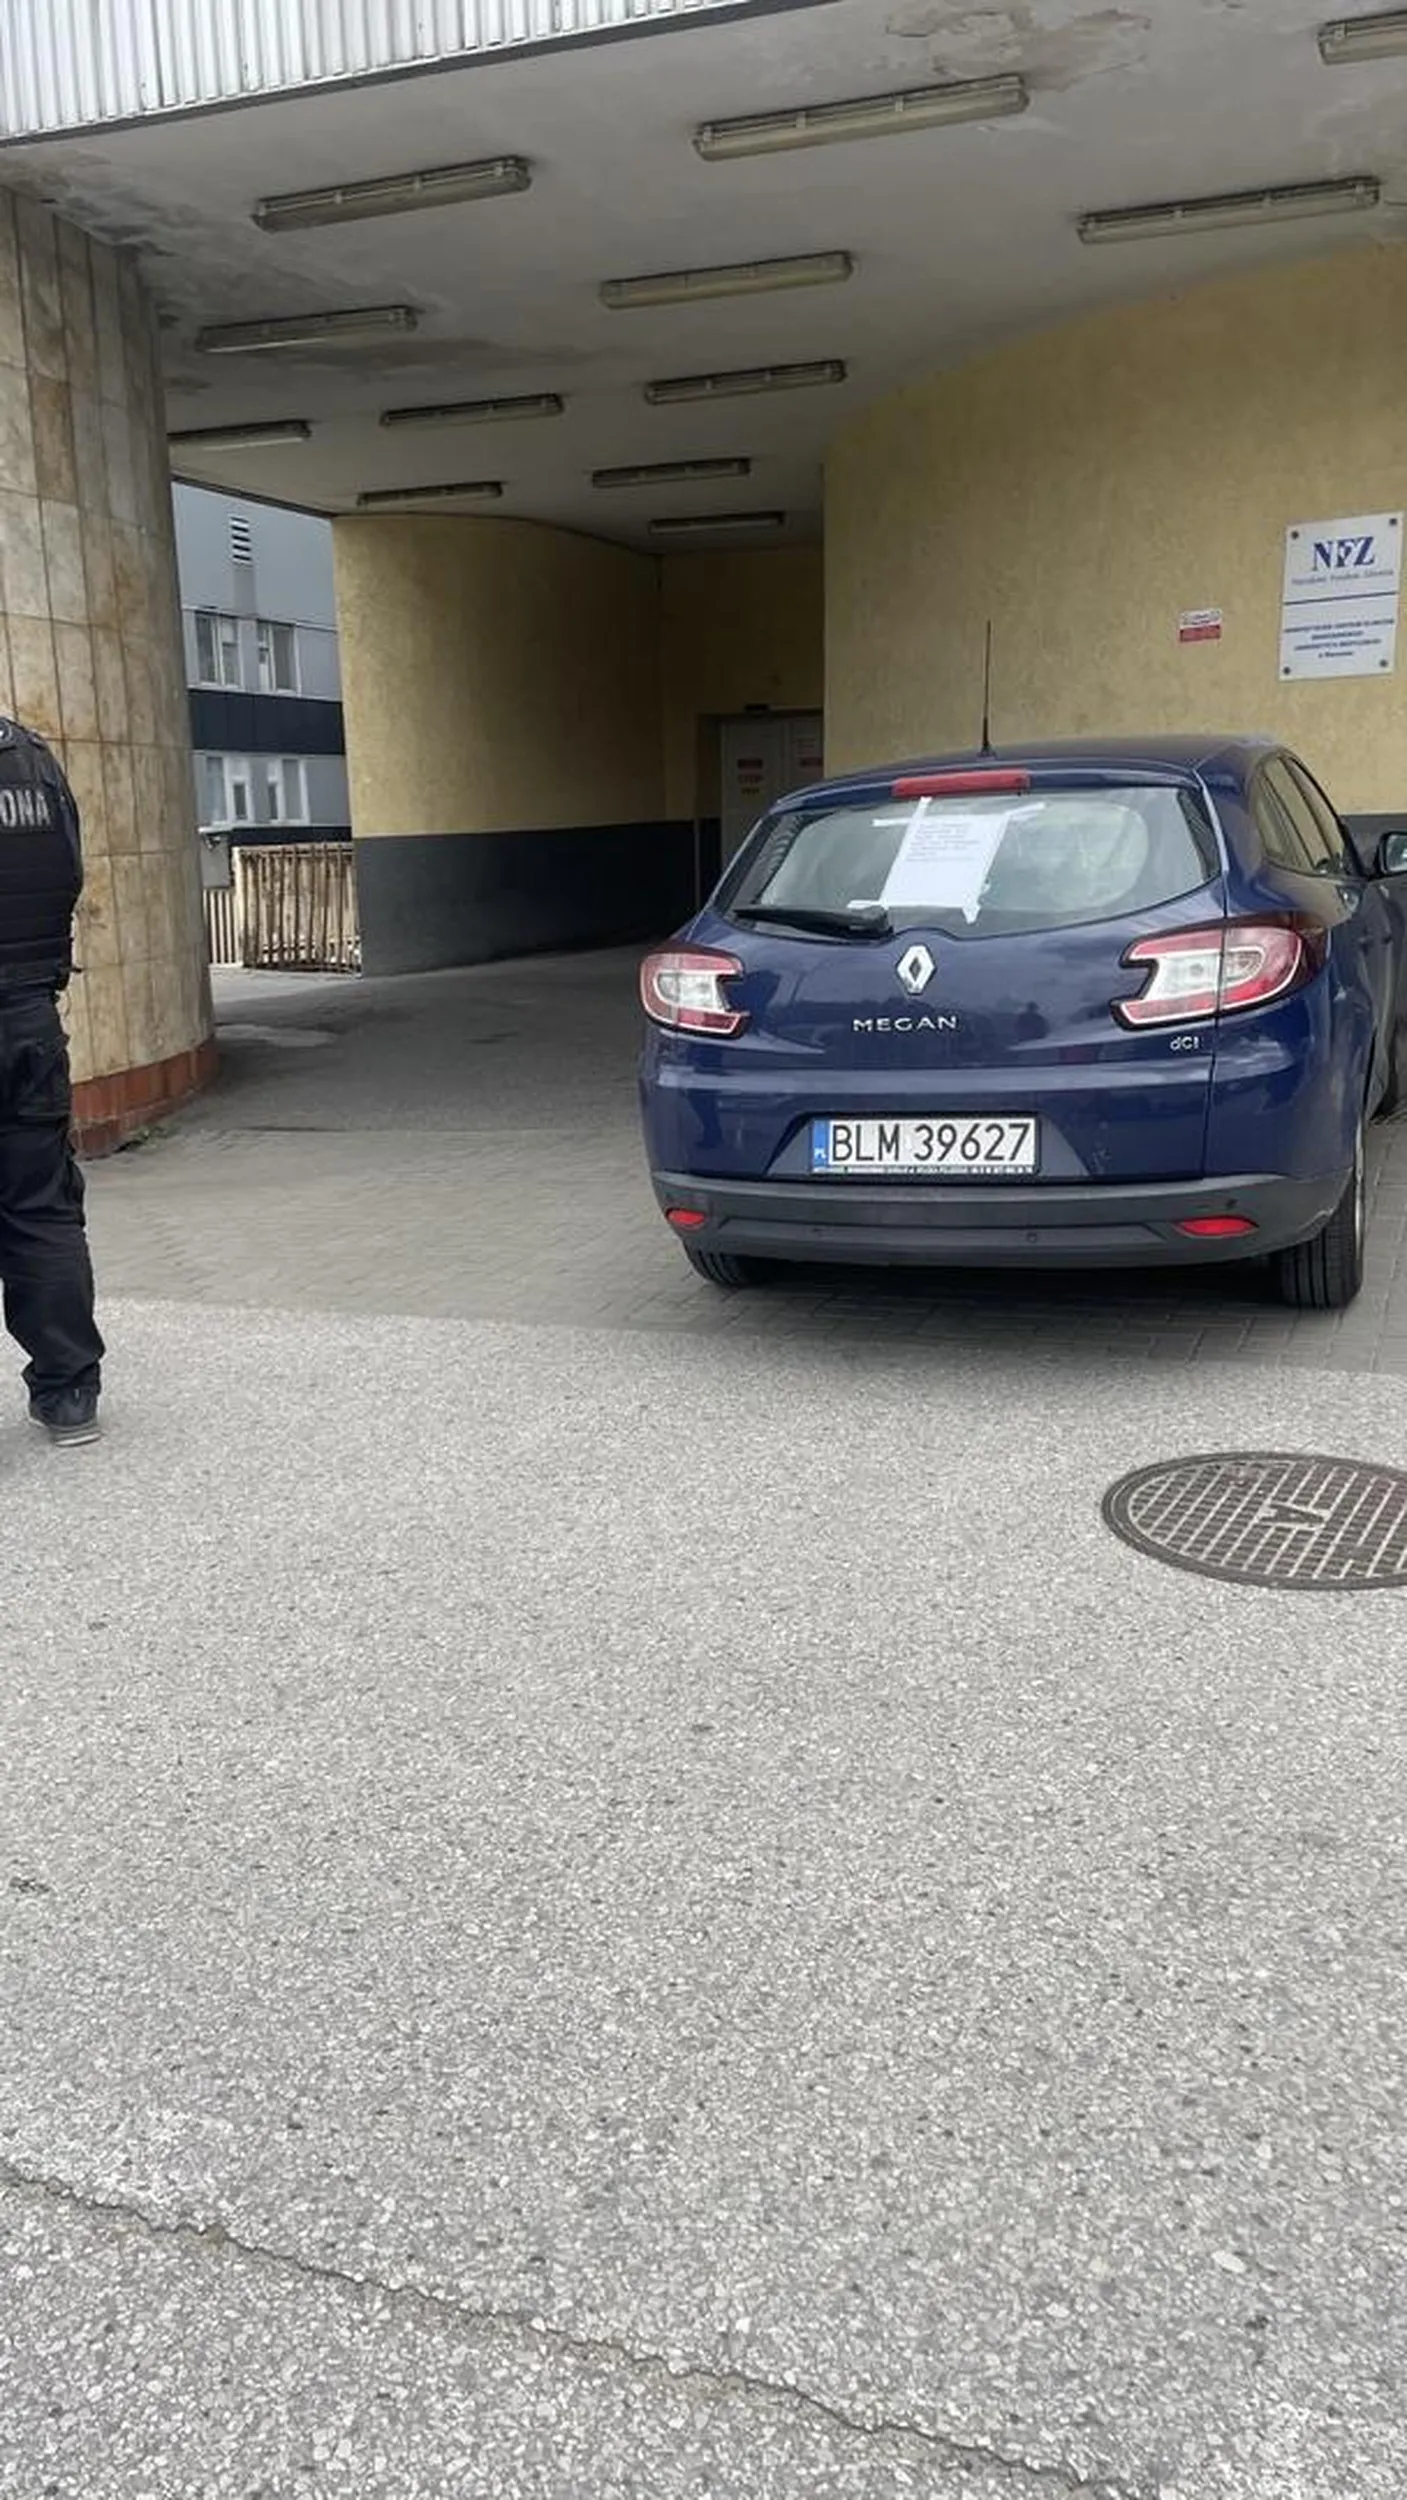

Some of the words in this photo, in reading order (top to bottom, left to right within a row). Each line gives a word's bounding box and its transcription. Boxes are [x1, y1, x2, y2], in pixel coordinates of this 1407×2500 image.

[1312, 536, 1375, 571] NFZ
[853, 1015, 957, 1032] MEGAN
[833, 1124, 900, 1161] BLM
[914, 1123, 1030, 1161] 39627
